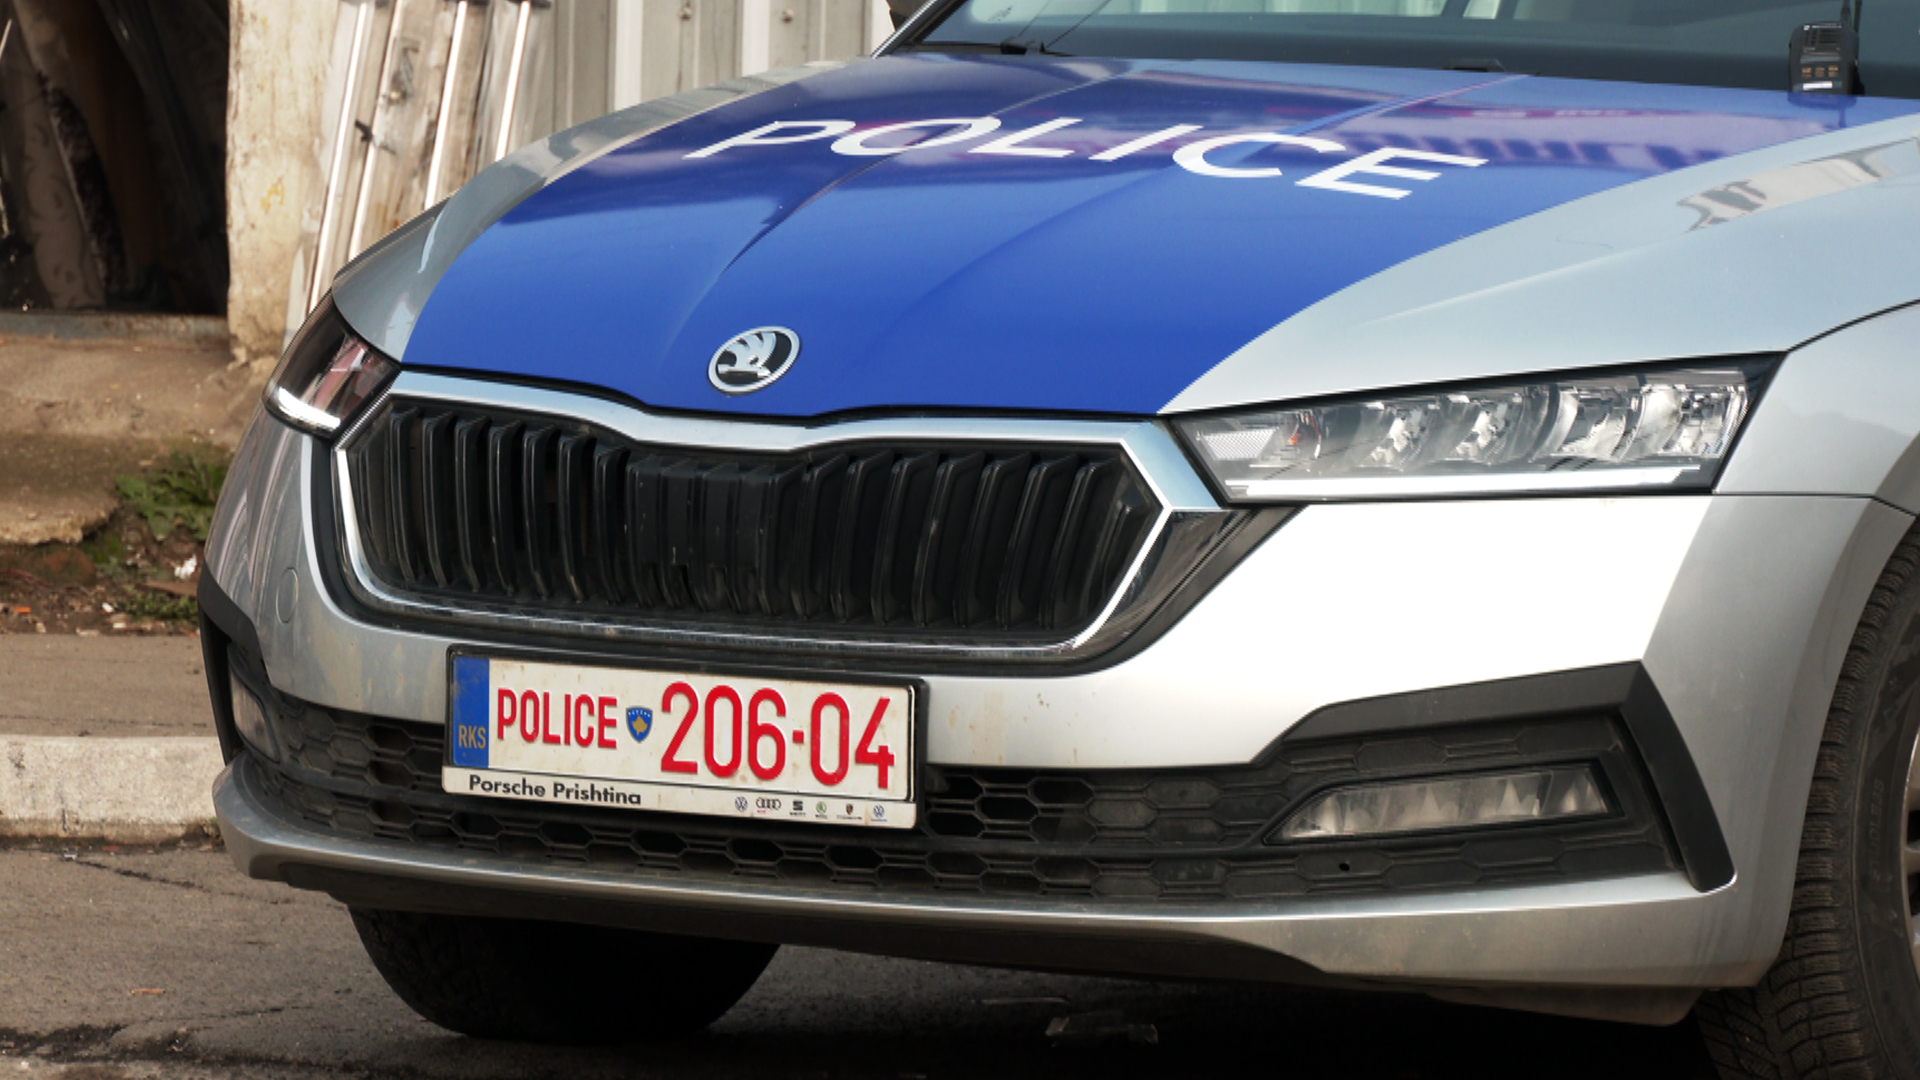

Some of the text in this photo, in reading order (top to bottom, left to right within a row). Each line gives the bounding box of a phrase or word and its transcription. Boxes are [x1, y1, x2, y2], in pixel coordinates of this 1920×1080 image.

[684, 117, 1489, 199] POLICE
[459, 725, 487, 748] RKS
[496, 680, 896, 789] POLICE 206-04
[469, 774, 641, 805] Porsche Prishtina
